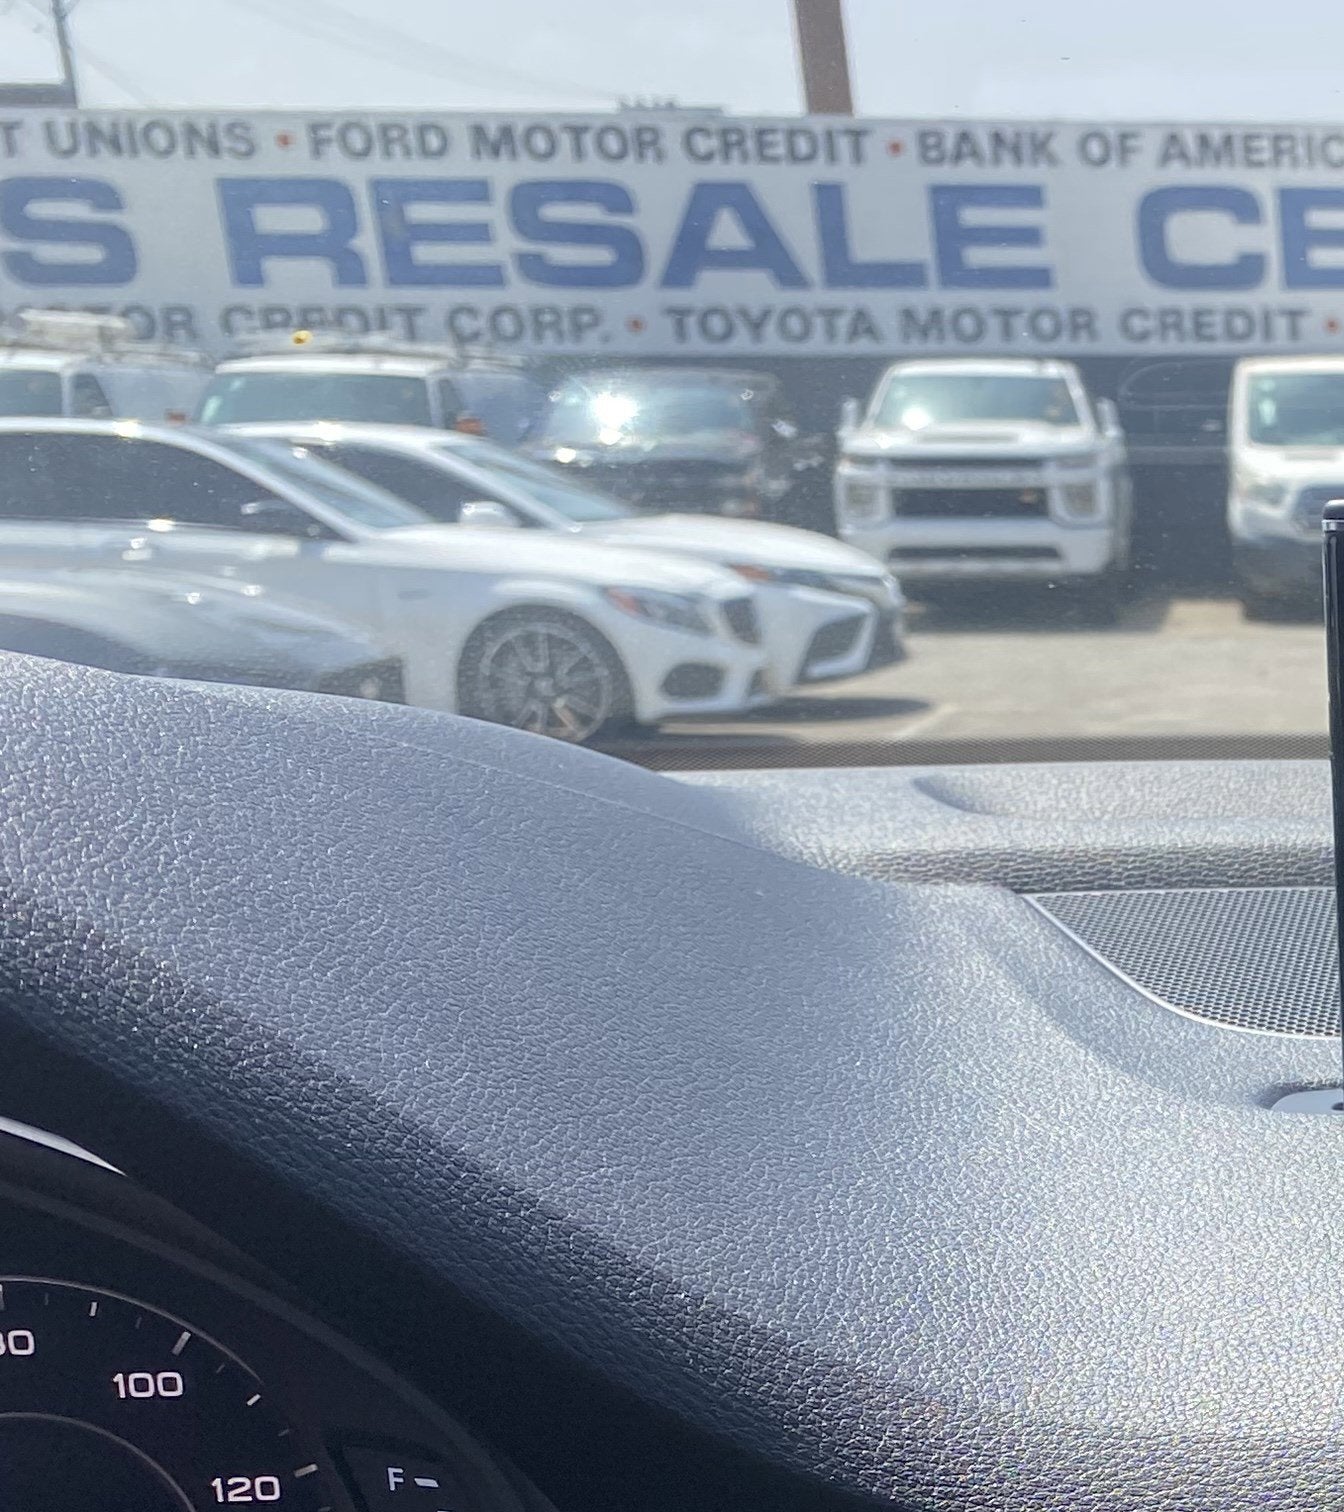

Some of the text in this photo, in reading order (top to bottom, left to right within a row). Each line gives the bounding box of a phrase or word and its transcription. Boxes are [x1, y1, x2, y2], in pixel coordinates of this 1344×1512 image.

[43, 121, 257, 160] UNIONS
[307, 122, 449, 161] FORD
[470, 124, 668, 163] MOTOR
[682, 127, 869, 166] CREDIT
[917, 130, 1060, 170] BANK
[1077, 130, 1141, 170] OF
[214, 177, 1057, 292] RESALE
[668, 306, 880, 346] TOYOTA
[901, 307, 1099, 347] MOTOR
[1118, 308, 1310, 346] CREDIT
[0, 1330, 35, 1356] 0
[112, 1372, 184, 1398] 100
[211, 1476, 281, 1502] 120
[387, 1467, 404, 1491] F
